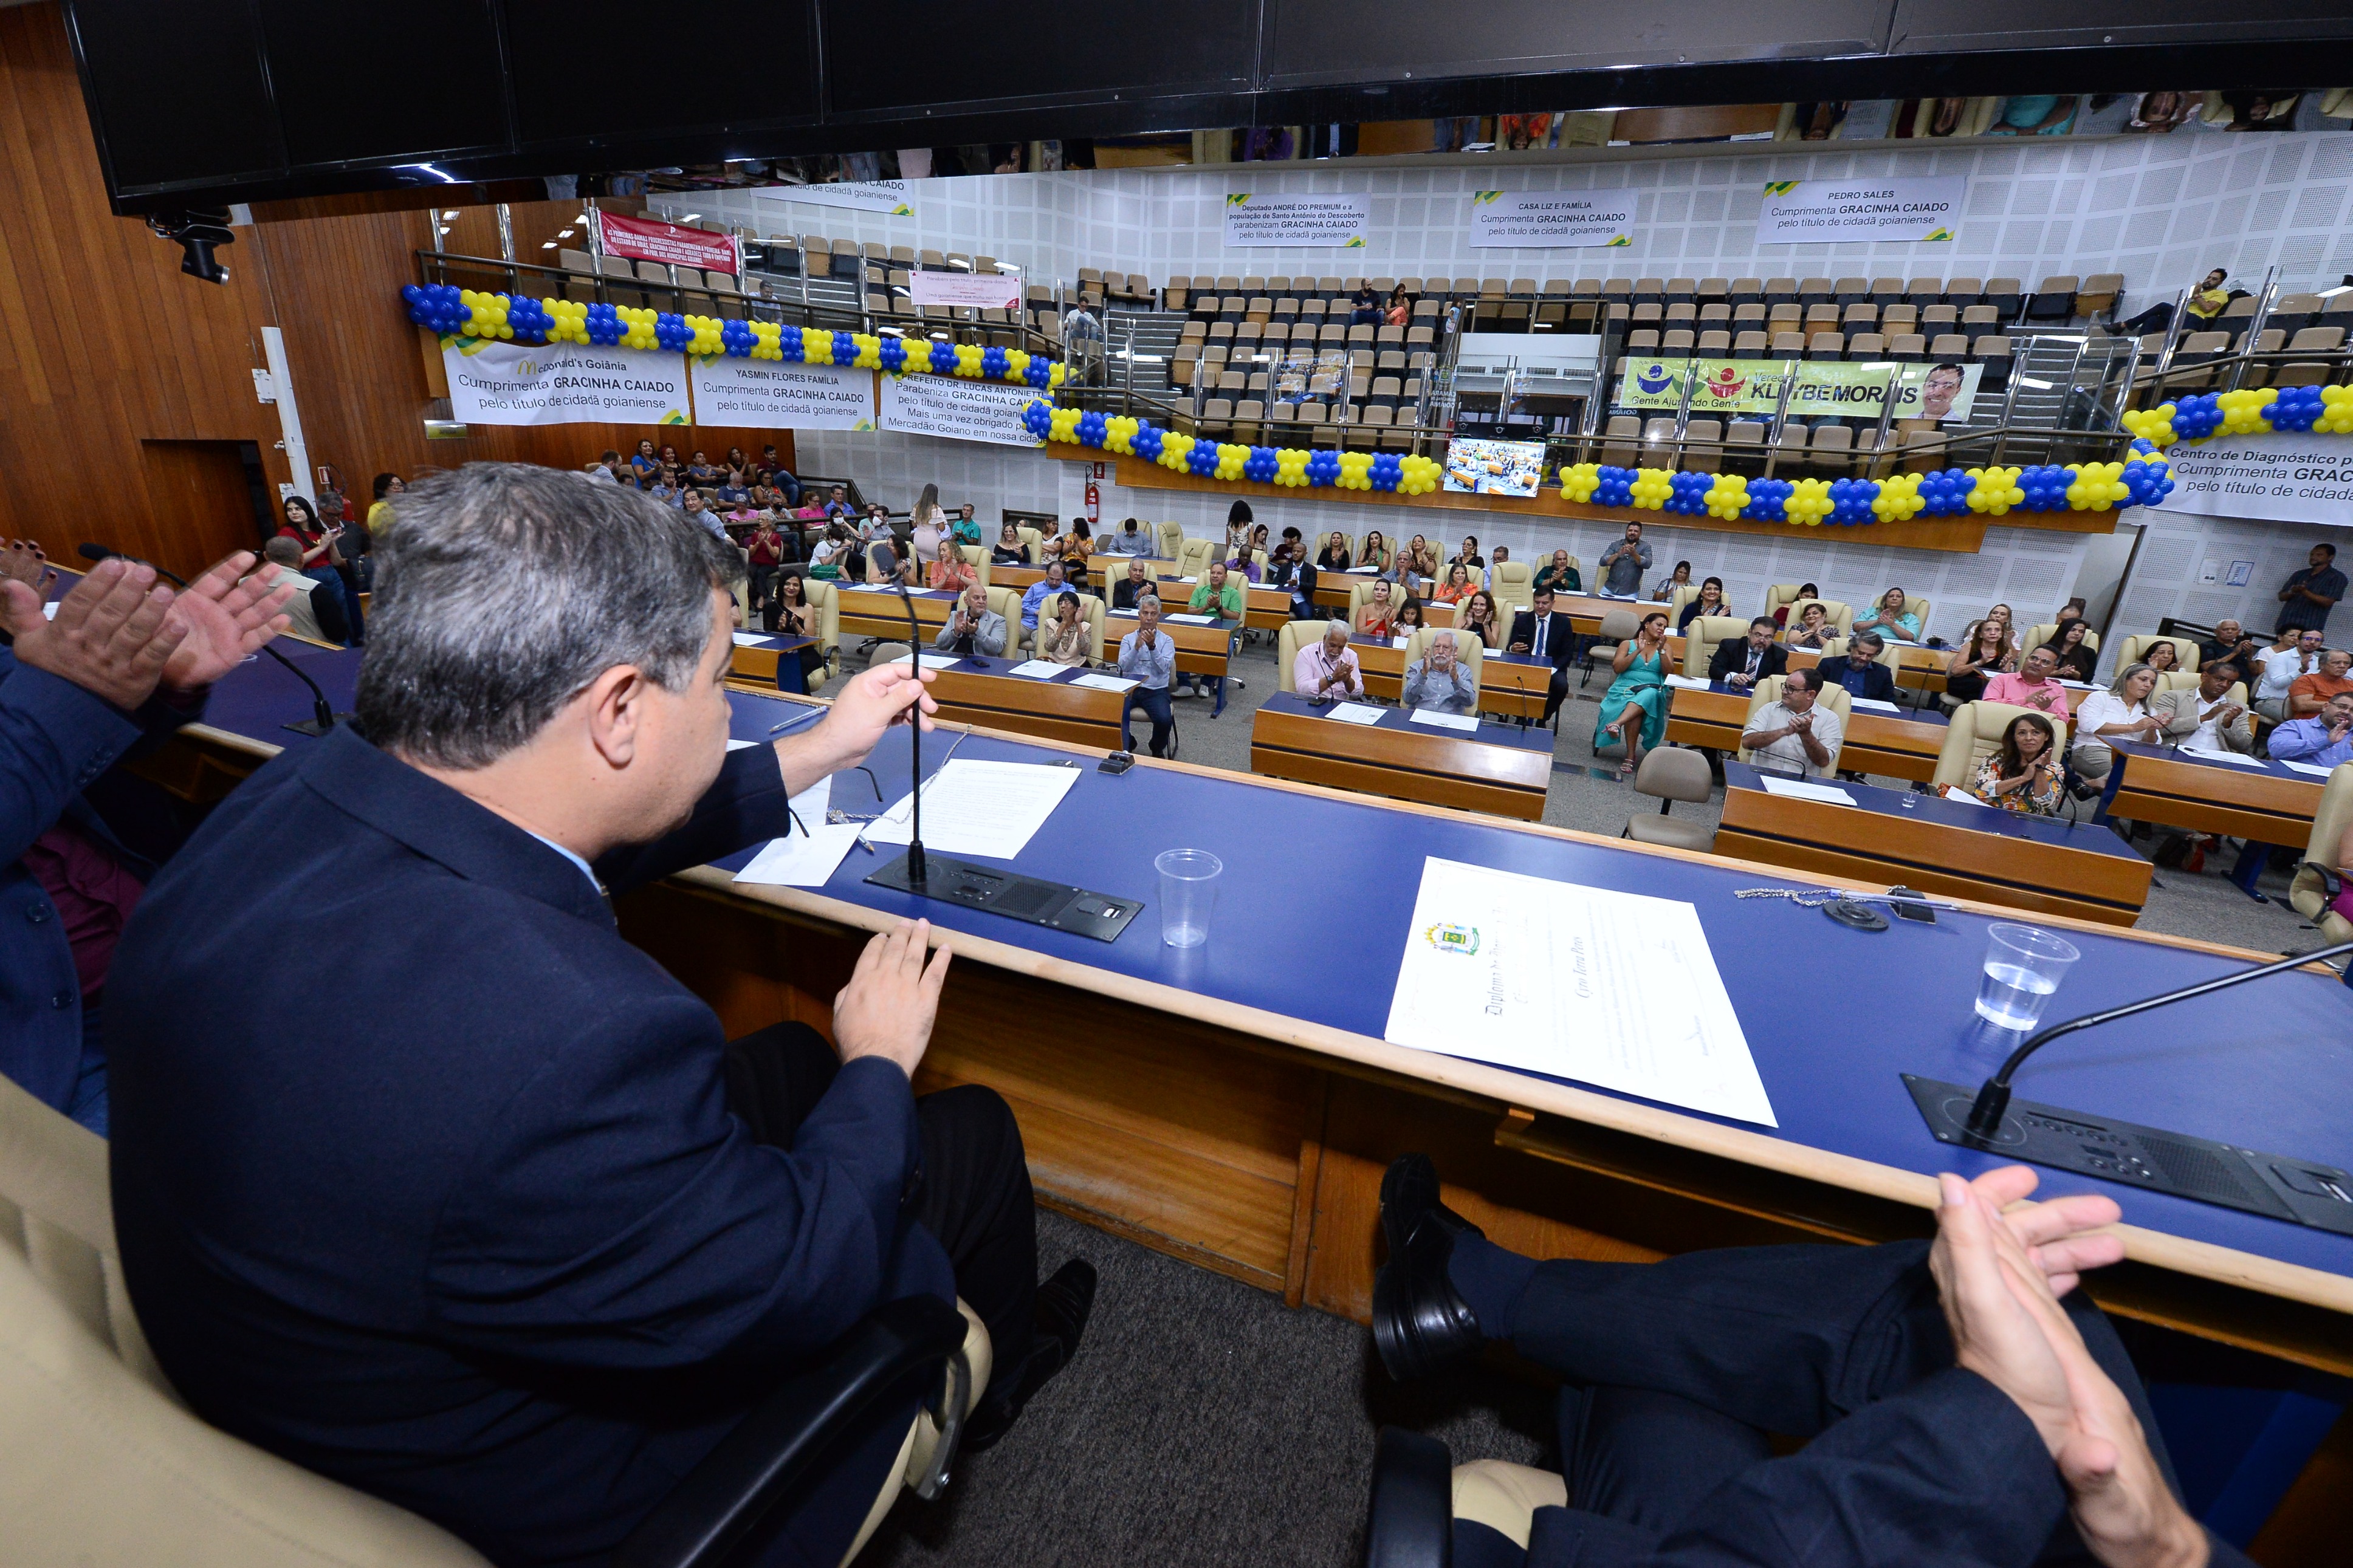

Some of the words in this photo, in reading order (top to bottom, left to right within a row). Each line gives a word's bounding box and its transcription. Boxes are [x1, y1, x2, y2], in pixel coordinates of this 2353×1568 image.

[870, 180, 904, 190] CAIADO
[825, 186, 852, 195] cidadã
[854, 190, 898, 201] goianiense
[1828, 191, 1860, 200] PEDRO
[1863, 190, 1894, 199] SALES
[1242, 204, 1271, 213] Deputado
[1561, 200, 1592, 209] FAMÍLIA
[1771, 207, 1836, 217] Cumprimenta
[1839, 204, 1899, 214] GRACINHA
[1902, 202, 1949, 212] CAIADO
[1234, 221, 1279, 230] parabenizam
[1481, 214, 1534, 224] Cumprimenta
[1537, 214, 1586, 223] GRACINHA
[1589, 213, 1626, 222] CAIADO
[1778, 219, 1799, 229] pelo
[1801, 217, 1825, 227] título
[1828, 217, 1840, 226] de
[1843, 216, 1877, 225] cidadã
[1879, 216, 1936, 227] goianiense
[1311, 231, 1350, 239] goianiense
[1488, 227, 1505, 236] pelo
[1508, 227, 1527, 235] título
[1529, 227, 1540, 235] de
[1541, 226, 1568, 235] cidadã
[1570, 226, 1615, 236] goianiense
[585, 359, 627, 371] Goiânia
[458, 374, 549, 392] Cumprimenta
[554, 377, 621, 390] GRACINHA
[624, 380, 674, 392] CAIADO
[736, 369, 769, 380] YASMIN
[772, 372, 805, 383] FLORES
[808, 374, 839, 385] FAMÍLIA
[902, 373, 944, 386] PREFEITO
[947, 380, 961, 389] DR.
[964, 383, 992, 393] LUCAS
[703, 382, 769, 395] Cumprimenta
[773, 388, 826, 400] GRACINHA
[828, 392, 864, 403] CAIADO
[895, 382, 949, 397] Parabeniza
[952, 391, 1006, 405] GRACINHA
[1009, 398, 1031, 407] CAI
[479, 398, 508, 409] pelo
[549, 395, 562, 406] de
[563, 394, 600, 406] cidadã
[603, 396, 666, 408] goianiense
[717, 400, 738, 412] pelo
[741, 401, 764, 411] título
[768, 403, 779, 413] de
[781, 403, 811, 414] cidadã
[813, 406, 858, 416] goianiense
[898, 395, 918, 405] pelo
[921, 397, 944, 408] título
[947, 402, 958, 410] de
[961, 404, 991, 414] cidadã
[994, 408, 1022, 418] goiani
[1632, 396, 1659, 405] Gente
[1662, 397, 1708, 407] Ajundo
[1711, 399, 1740, 408] Gente
[907, 408, 929, 418] Mais
[974, 417, 1013, 429] obrigado
[888, 417, 935, 430] Mercadão
[938, 423, 970, 436] Goiano
[990, 431, 1017, 440] nossa
[2170, 448, 2217, 459] Centro
[2221, 451, 2239, 460] de
[2243, 451, 2337, 464] Diagnóstico
[2177, 462, 2287, 479] Cumprimenta
[2185, 480, 2219, 492] pelo
[2225, 482, 2265, 495] título
[2271, 484, 2293, 496] de
